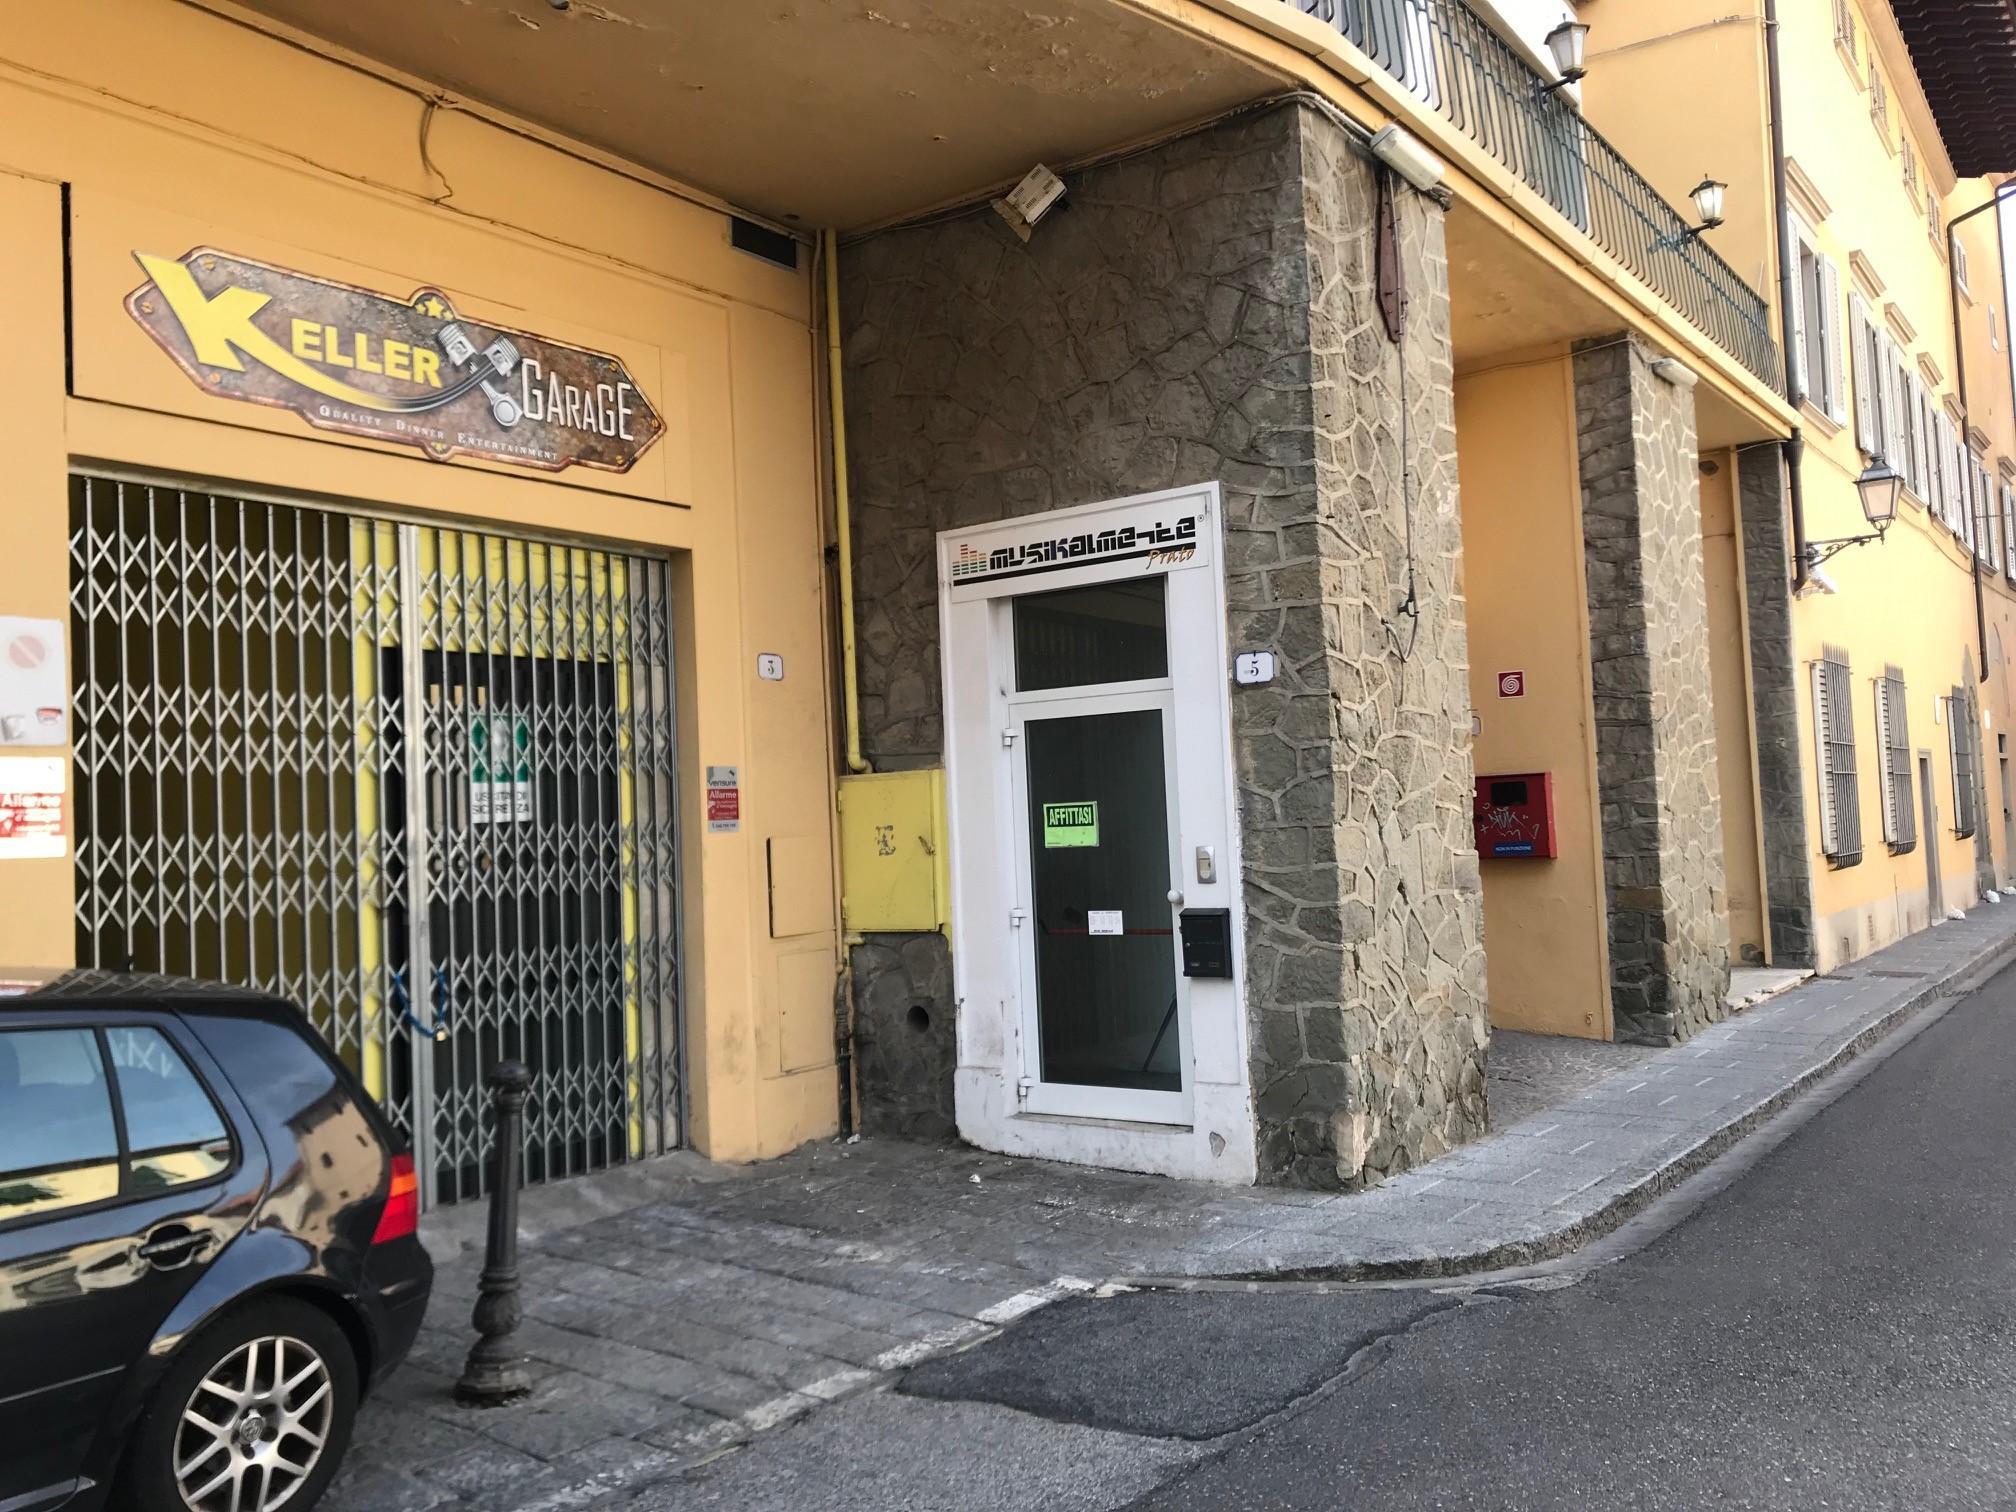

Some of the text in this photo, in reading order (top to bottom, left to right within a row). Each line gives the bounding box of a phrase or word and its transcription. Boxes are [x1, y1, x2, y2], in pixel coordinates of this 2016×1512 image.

[131, 249, 635, 441] KELLER GARAGE
[319, 404, 558, 460] QUALITY DINNER ENTERTAINMENT
[1145, 545, 1195, 570] Prato
[1250, 660, 1259, 676] 5
[1049, 806, 1092, 825] AFFITTASI
